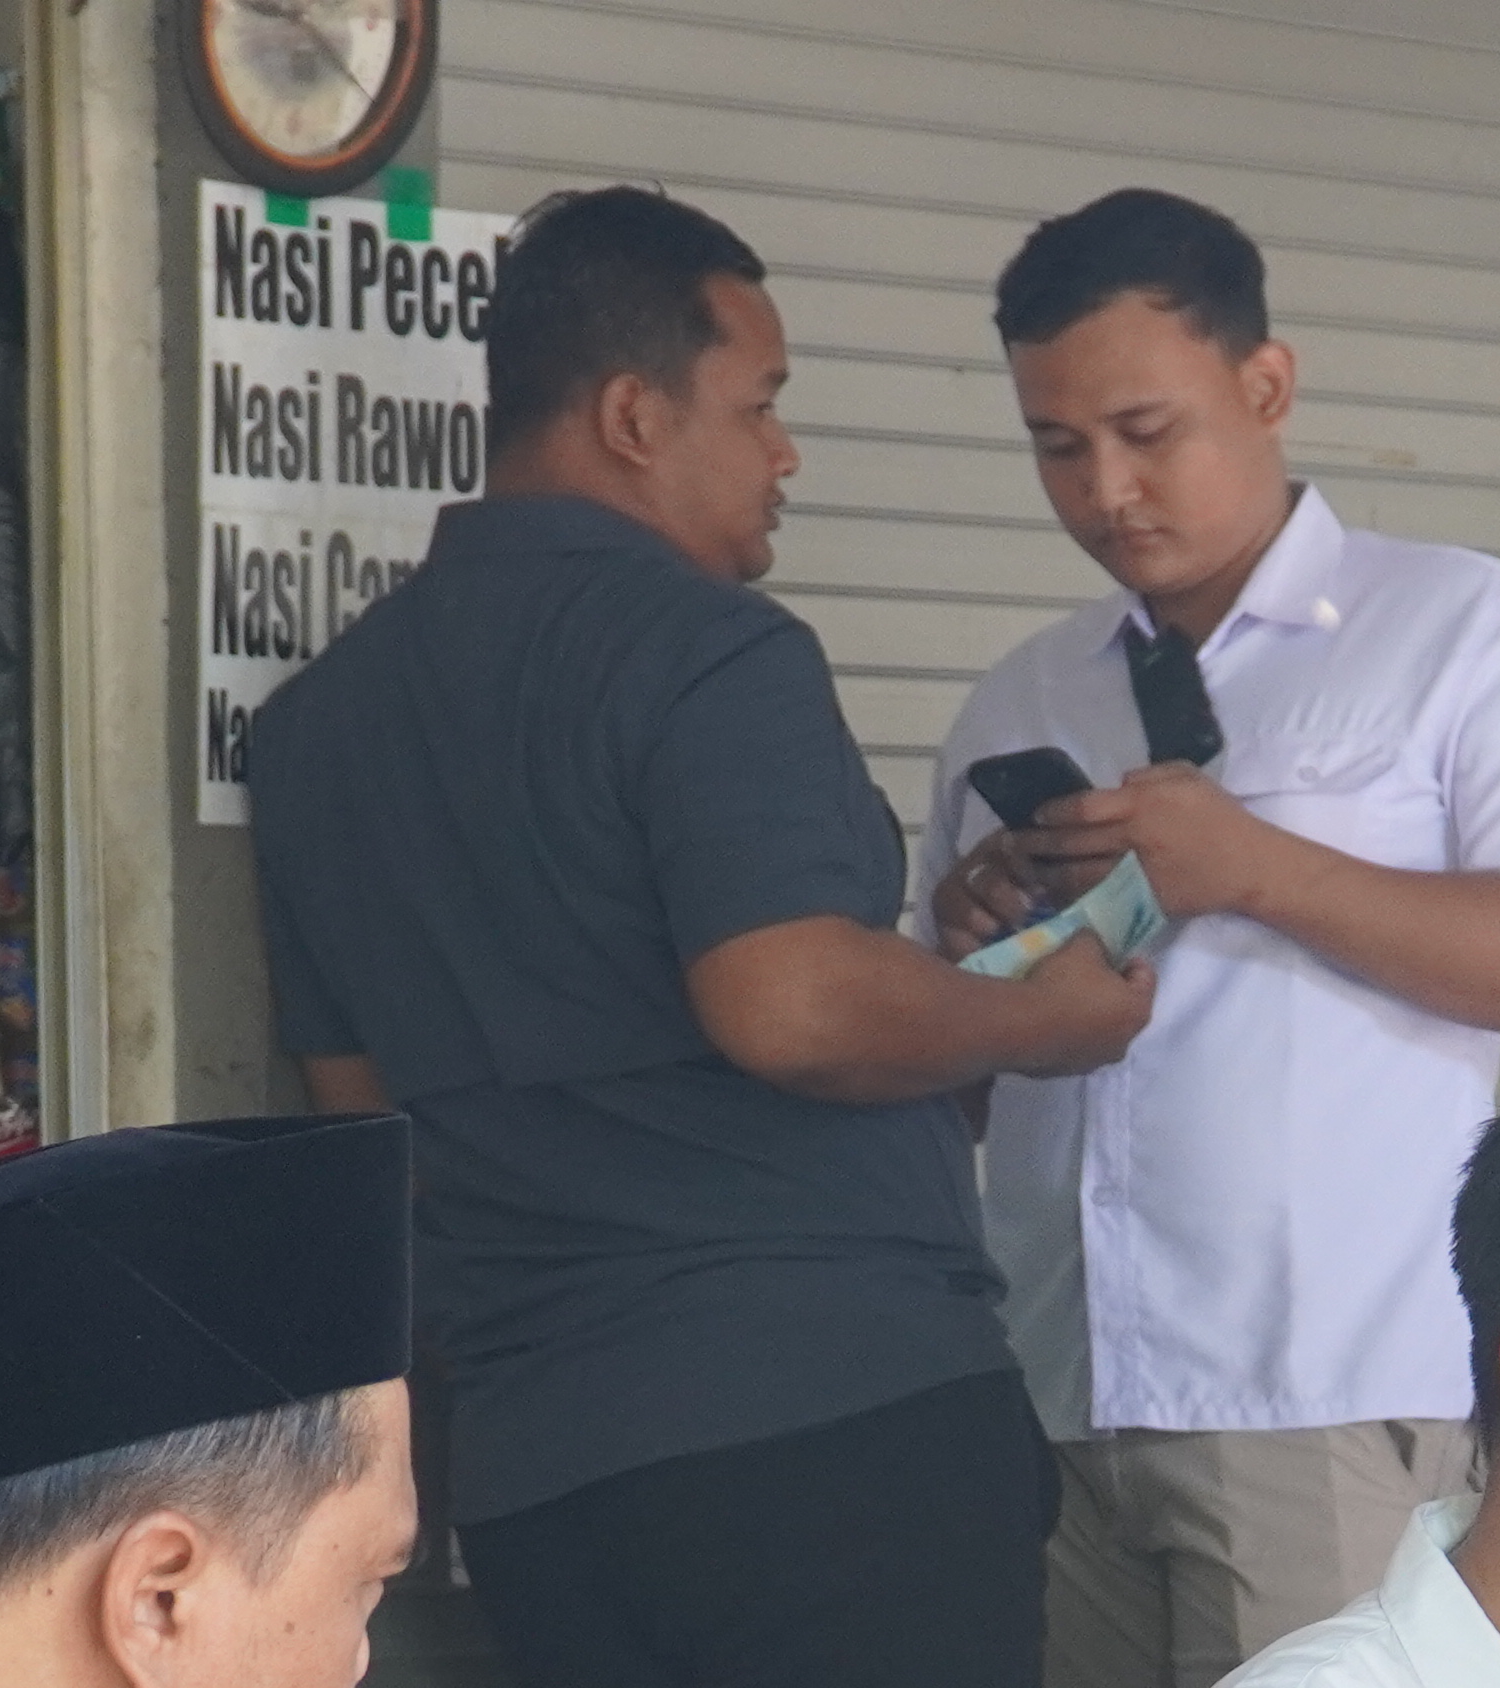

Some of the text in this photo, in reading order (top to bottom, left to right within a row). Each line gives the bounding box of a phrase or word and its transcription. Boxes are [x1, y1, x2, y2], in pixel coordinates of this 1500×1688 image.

[212, 203, 505, 342] Nasi Pece
[210, 361, 494, 494] Nasi Rawo
[210, 522, 313, 661] Nasi
